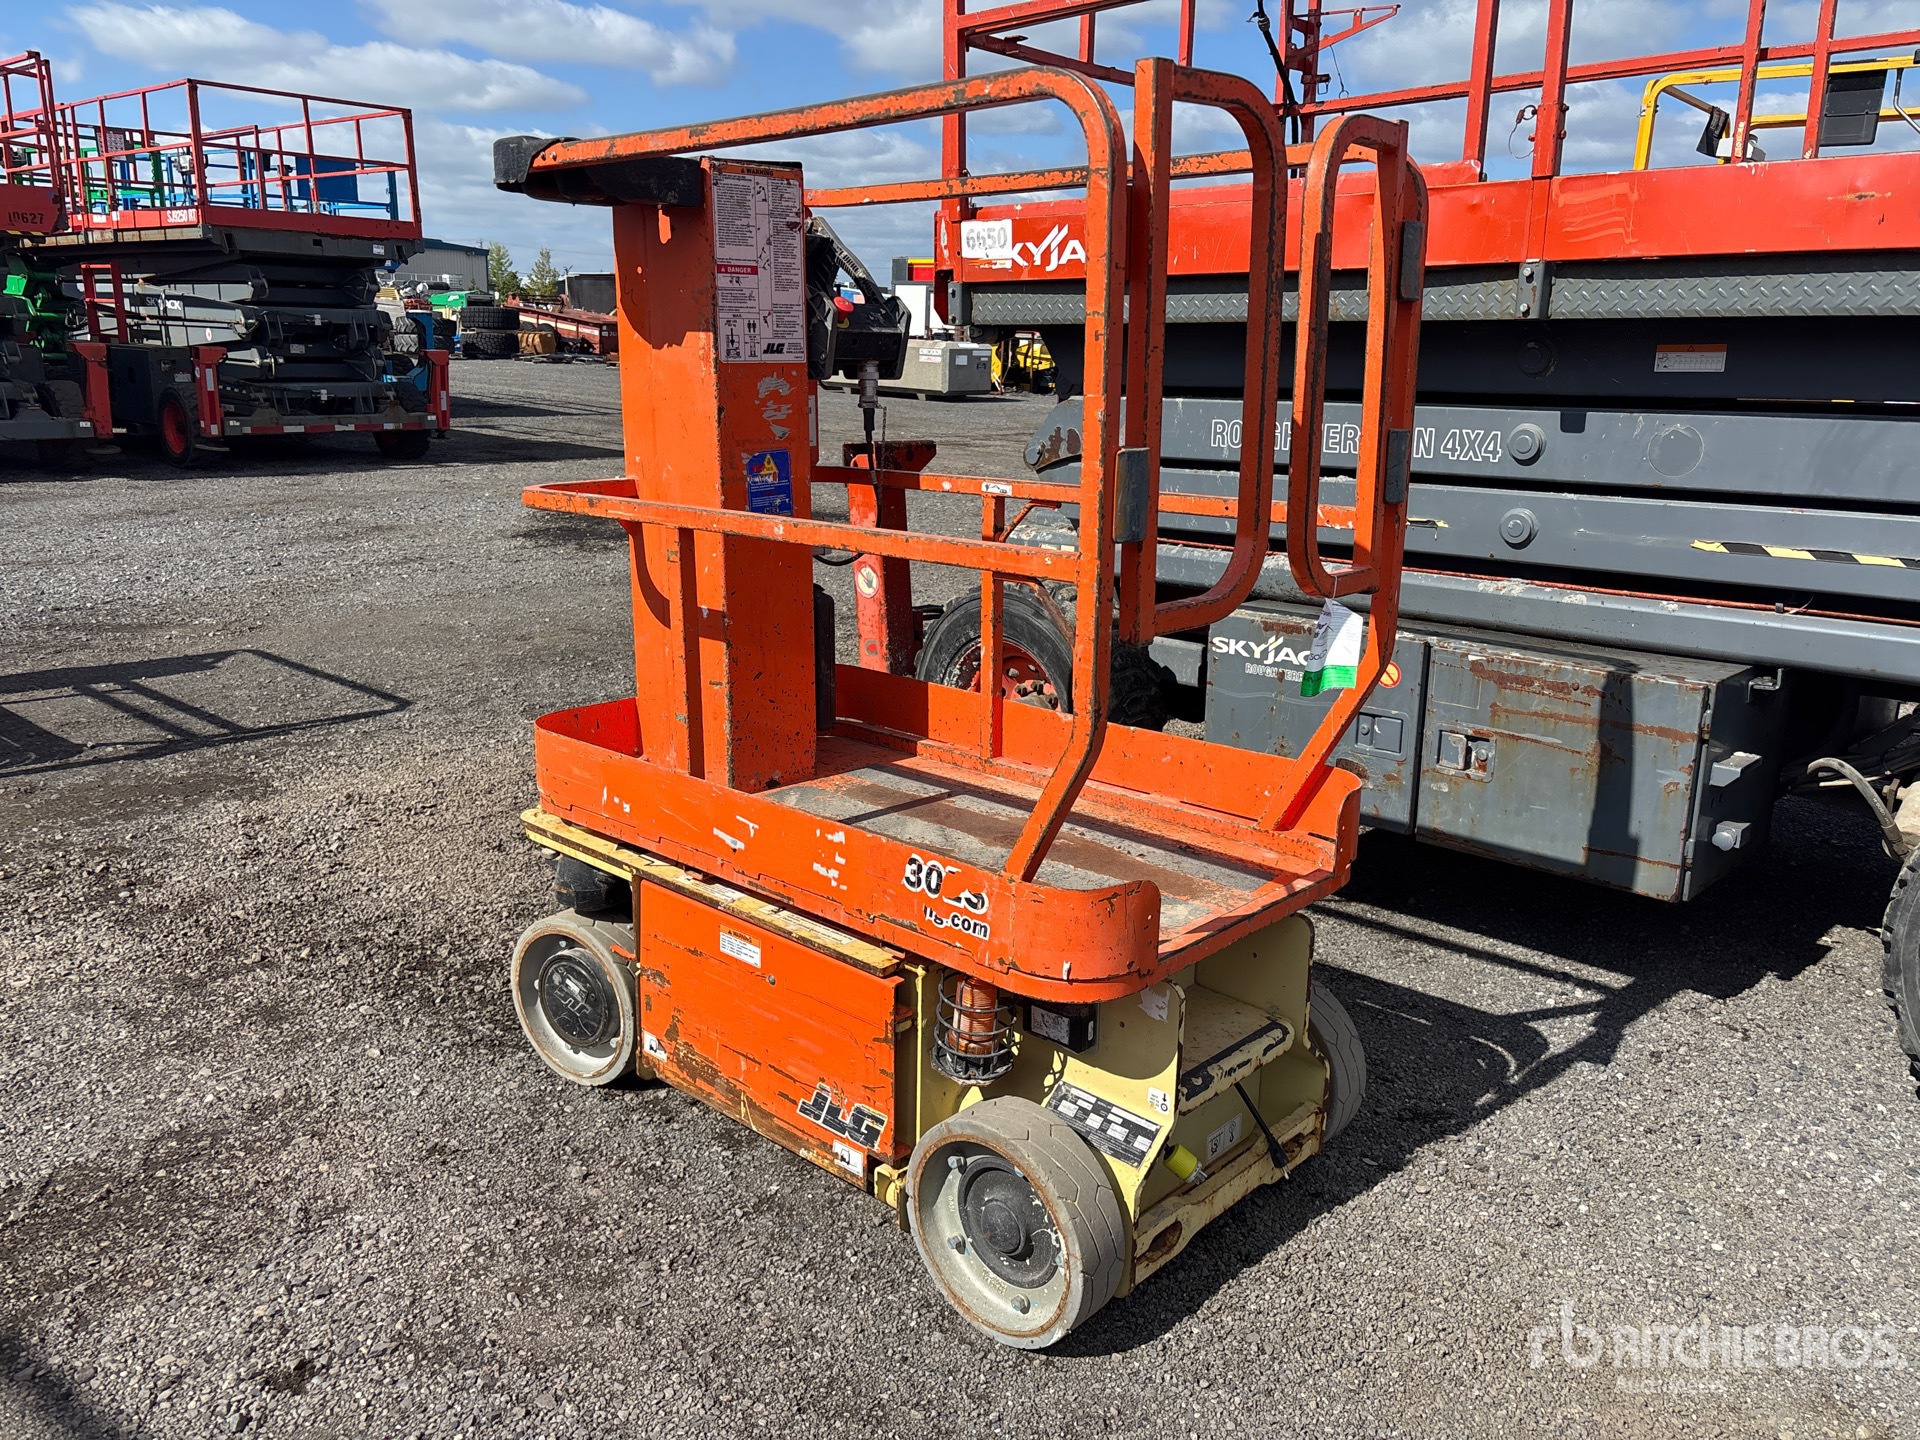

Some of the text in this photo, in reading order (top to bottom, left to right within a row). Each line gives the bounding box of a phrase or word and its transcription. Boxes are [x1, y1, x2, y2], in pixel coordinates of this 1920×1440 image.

[188, 208, 197, 222] RT
[1012, 224, 1086, 272] KYJA
[762, 342, 785, 354] JLG
[1441, 429, 1502, 463] 4X4
[1212, 635, 1311, 667] SKYJAC
[1245, 662, 1278, 679] ROUGH
[797, 1083, 888, 1152] JLG
